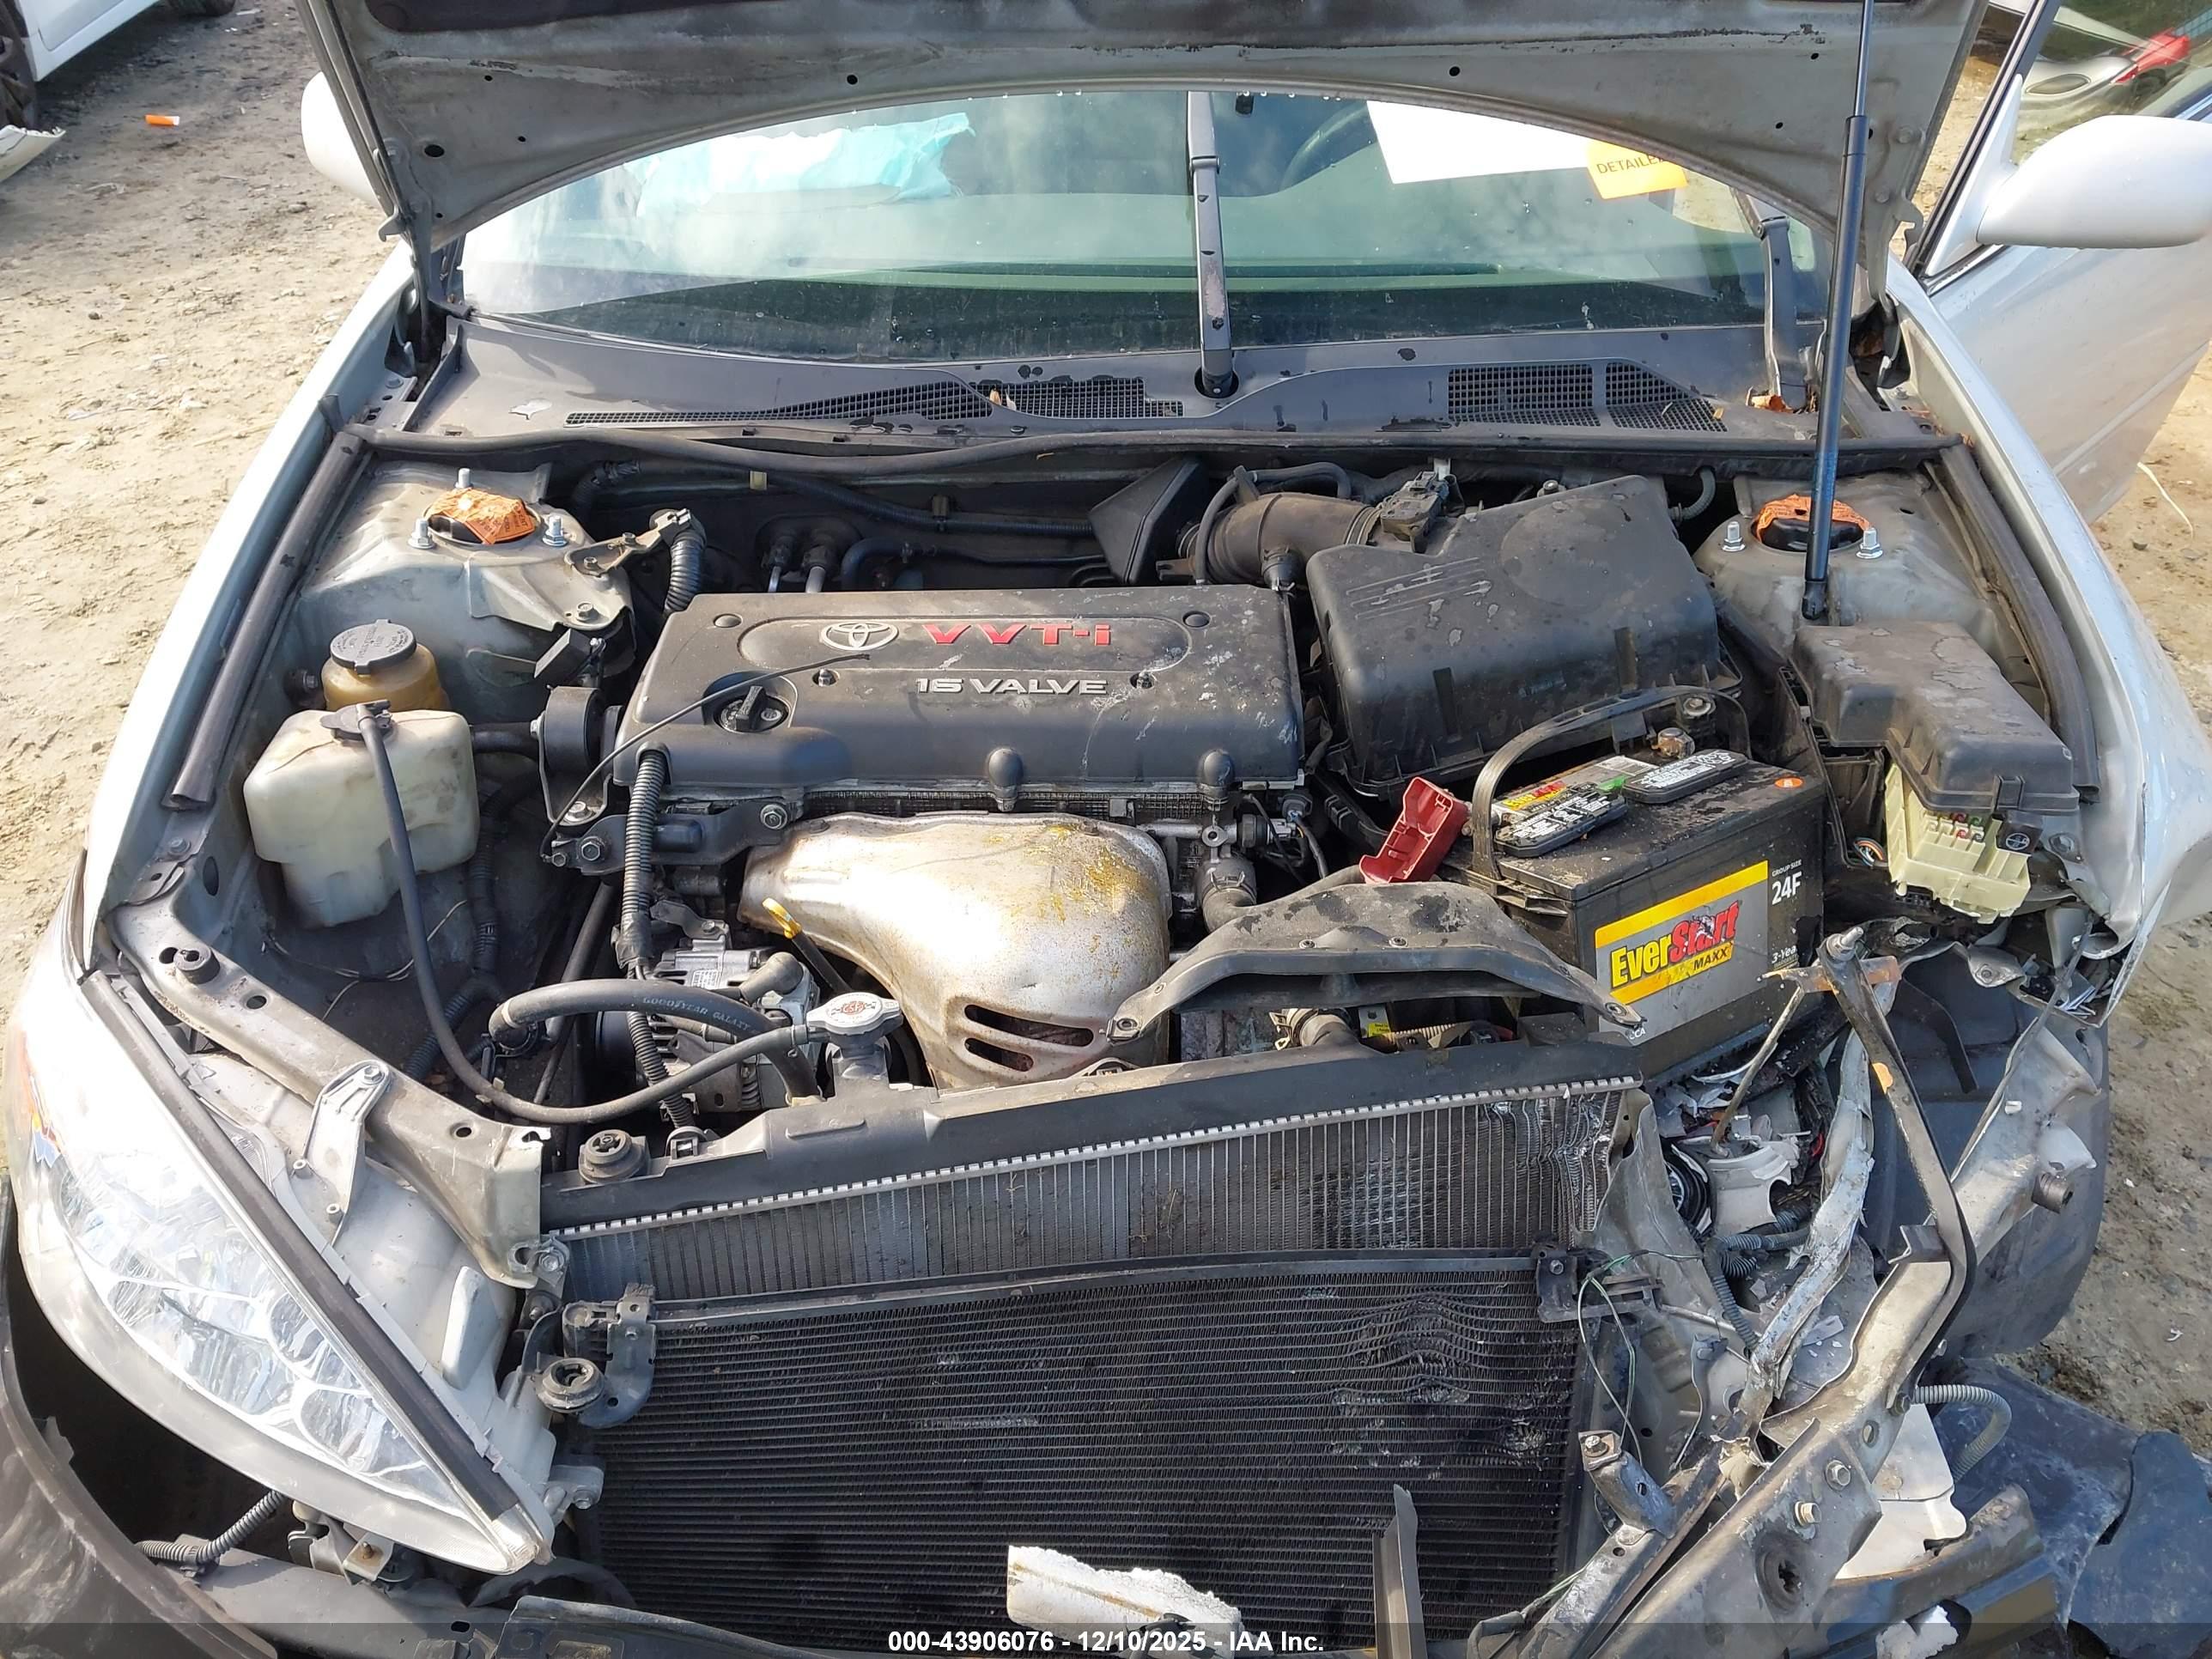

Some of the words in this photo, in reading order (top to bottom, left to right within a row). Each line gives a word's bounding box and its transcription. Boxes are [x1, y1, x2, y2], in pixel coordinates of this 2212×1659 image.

[1596, 155, 1663, 174] DETAILE
[921, 623, 1111, 646] VVT-i
[915, 678, 964, 695] 16
[969, 678, 1109, 695] VALVE
[1771, 863, 1790, 878] GROUP
[1790, 859, 1802, 870] SIZE
[1771, 871, 1802, 905] 24F
[1610, 900, 1740, 989] EverStart
[1771, 945, 1799, 964] 3-Yea
[1693, 947, 1729, 971] MAXX
[713, 1011, 751, 1031] GALAXY
